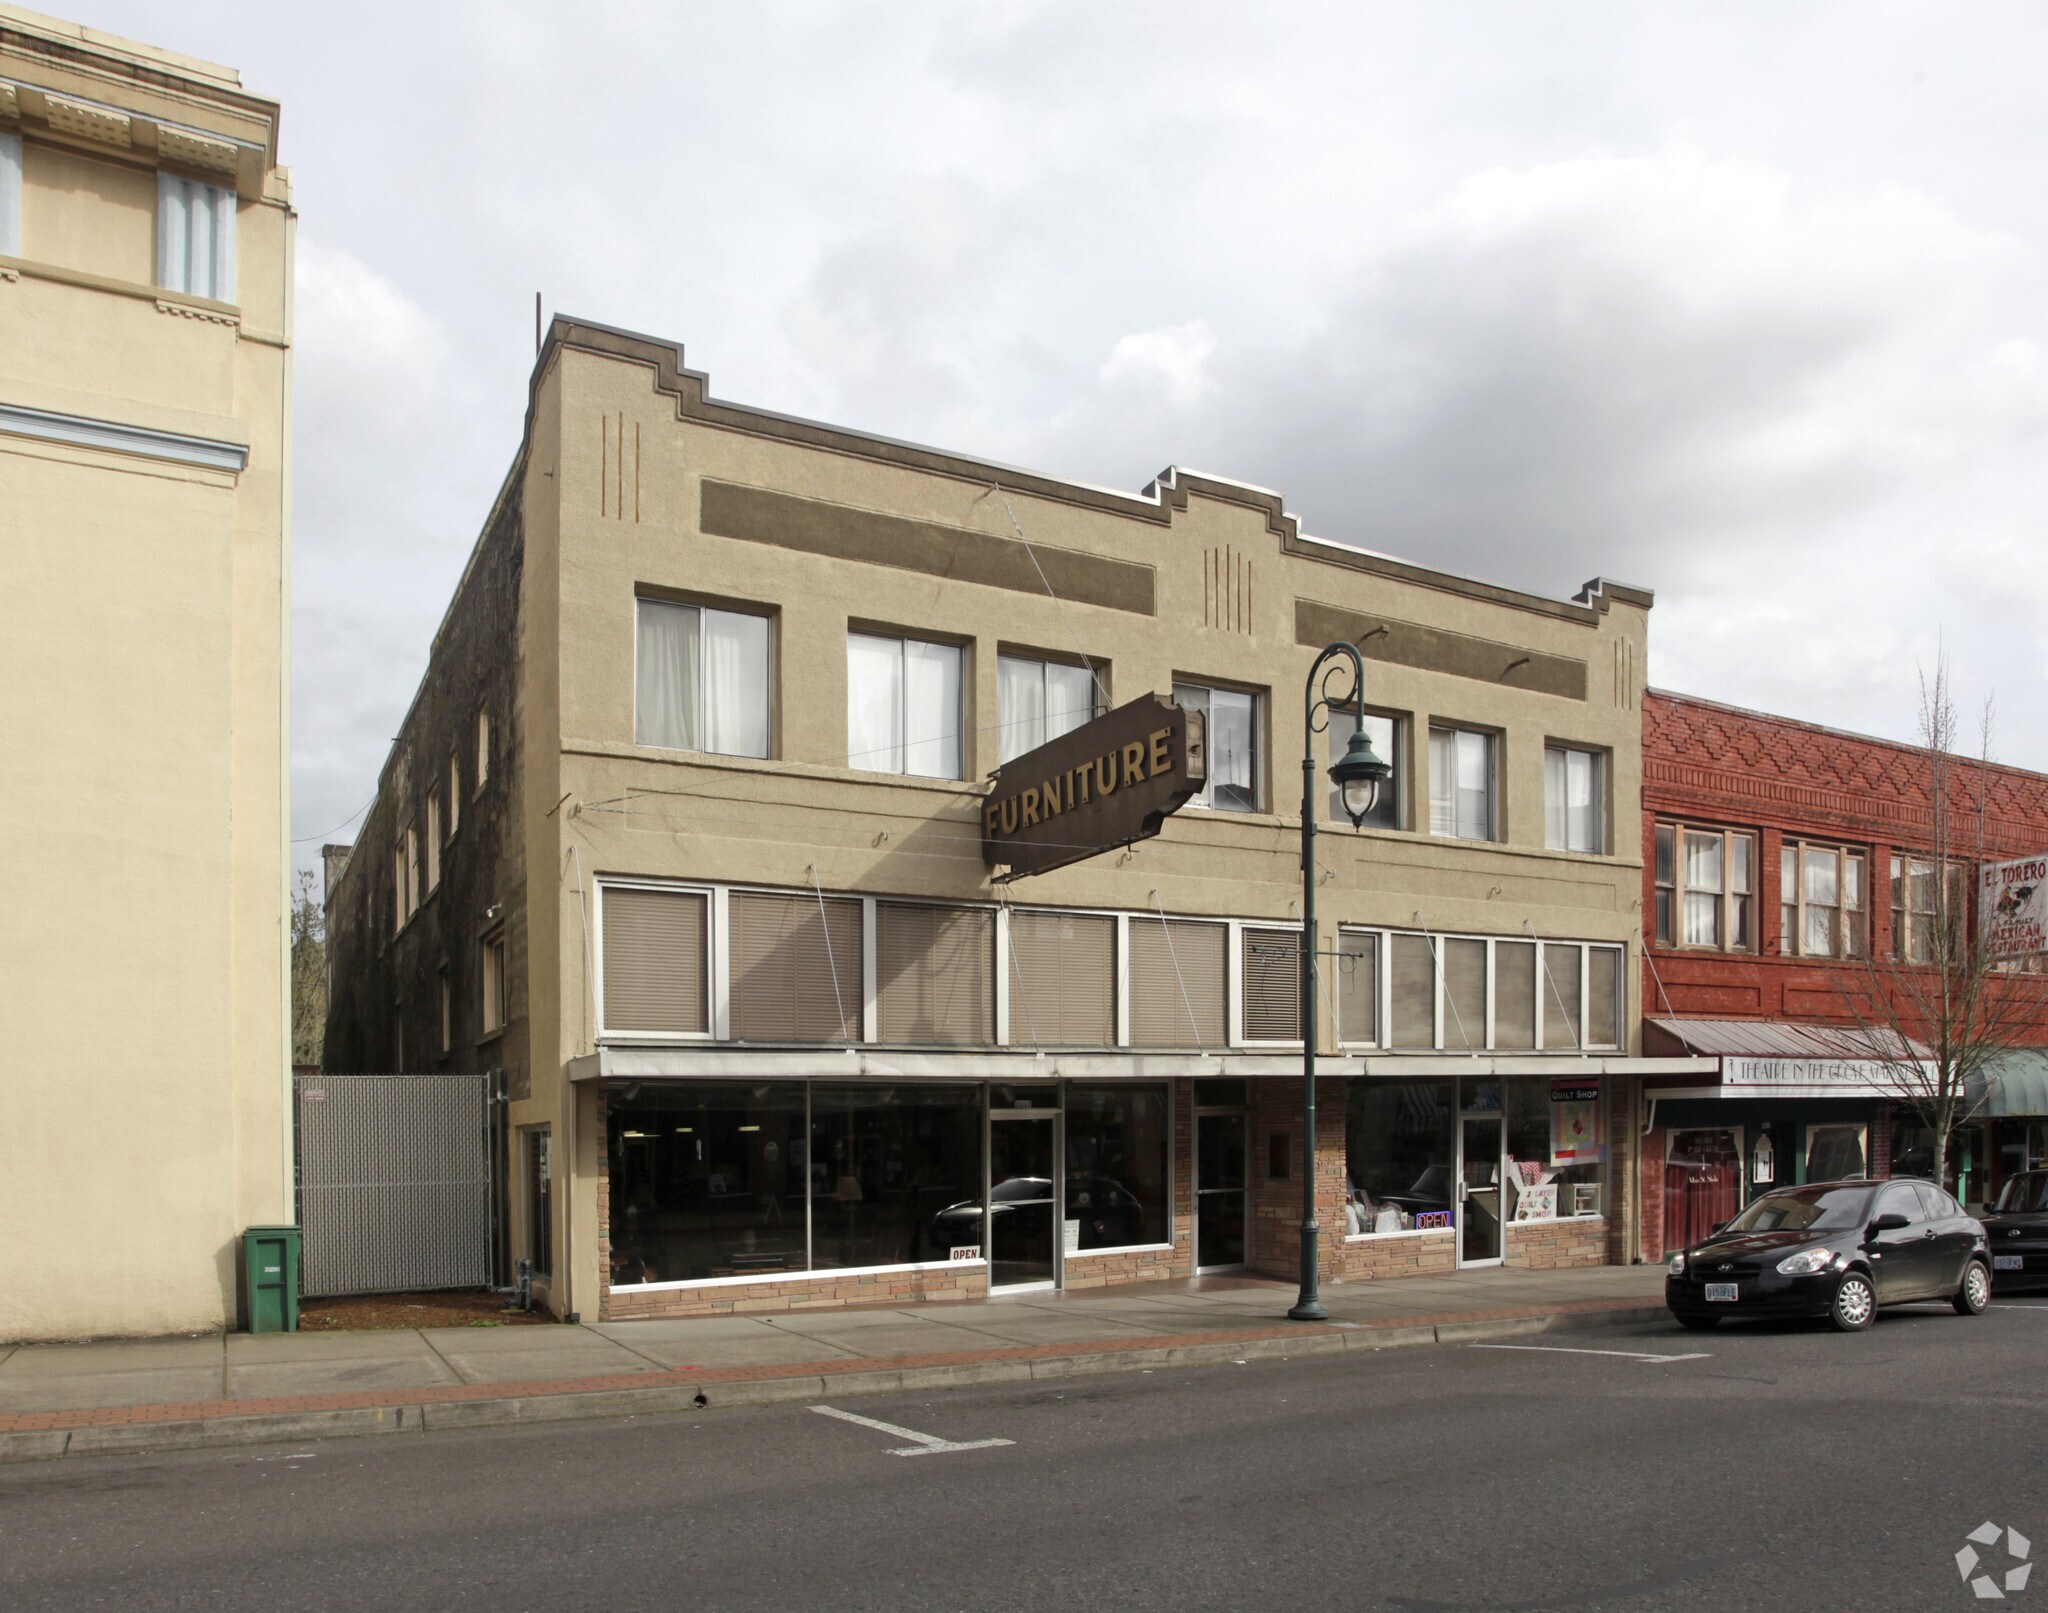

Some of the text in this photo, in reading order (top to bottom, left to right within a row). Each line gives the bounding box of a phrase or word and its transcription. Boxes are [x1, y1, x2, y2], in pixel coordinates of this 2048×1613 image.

[985, 726, 1172, 839] FURNITURE
[1985, 862, 2046, 887] EL TORERO
[1993, 923, 2040, 941] MEXICAN
[1985, 936, 2046, 954] STAURANT
[1741, 1062, 1789, 1079] THEATRE
[1808, 1063, 1825, 1079] THE
[1552, 1090, 1597, 1099] QUILT SHOP
[1519, 1201, 1537, 1209] QUILT
[1418, 1213, 1448, 1229] OPEN
[1532, 1210, 1551, 1218] SHOP
[953, 1249, 977, 1260] OPEN
